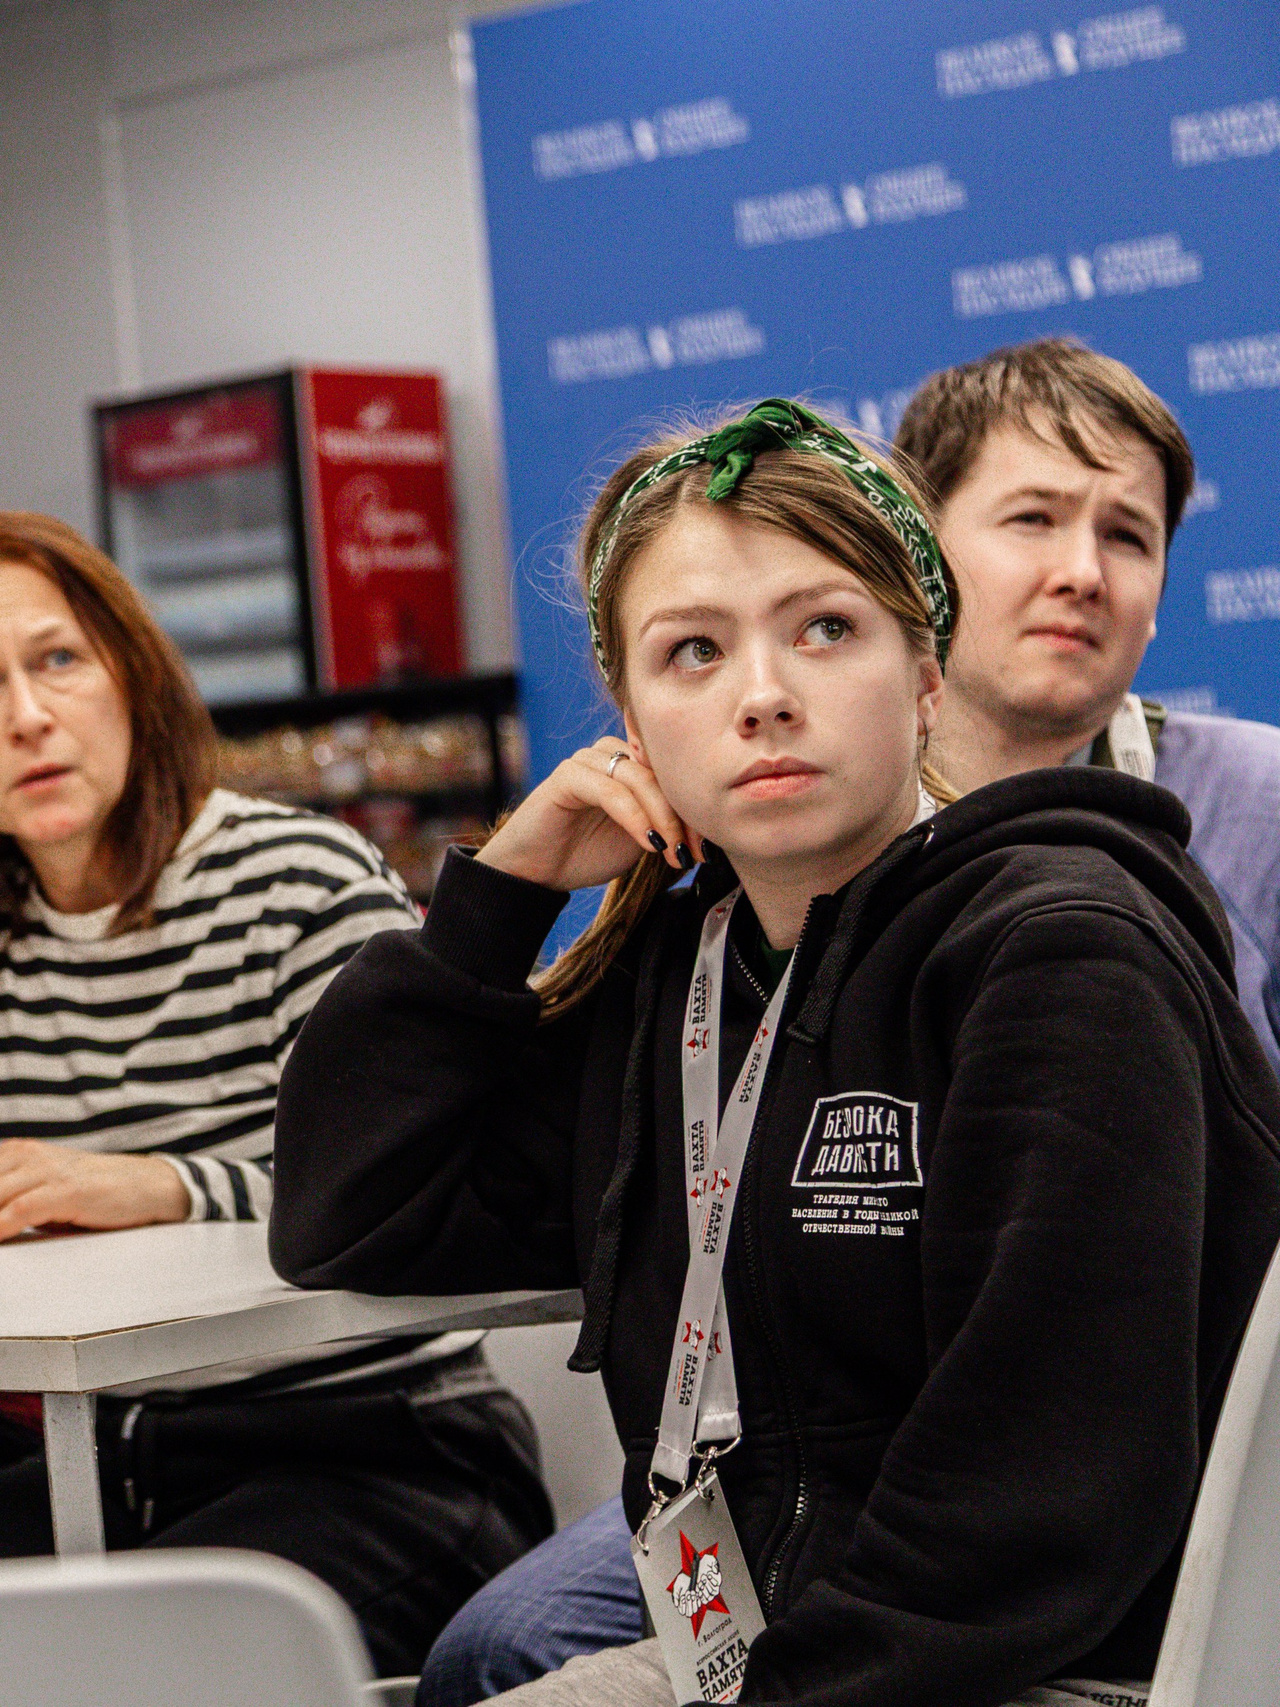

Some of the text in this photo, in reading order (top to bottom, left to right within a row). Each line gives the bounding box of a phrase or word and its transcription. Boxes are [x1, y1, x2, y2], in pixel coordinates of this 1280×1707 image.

[692, 975, 702, 1025] ВАХТА
[743, 1052, 761, 1103] ВАХТА
[691, 1121, 699, 1173] ВАХТА
[791, 1208, 839, 1219] НАСЕЛЕНИЯ
[842, 1210, 850, 1219] В
[854, 1209, 880, 1221] ГОДЫ
[813, 1194, 860, 1206] ТРАГЕДИЯ
[703, 1201, 718, 1254] ПАМЯТИ
[708, 1203, 723, 1255] ВАХТА
[802, 1223, 877, 1235] ОТЕЧЕСТВЕННОЙ
[679, 1353, 693, 1405] ПАМЯТИ
[684, 1355, 698, 1406] ВАХТА
[703, 1617, 732, 1643] Волгоград
[696, 1638, 749, 1689] ВАХТА
